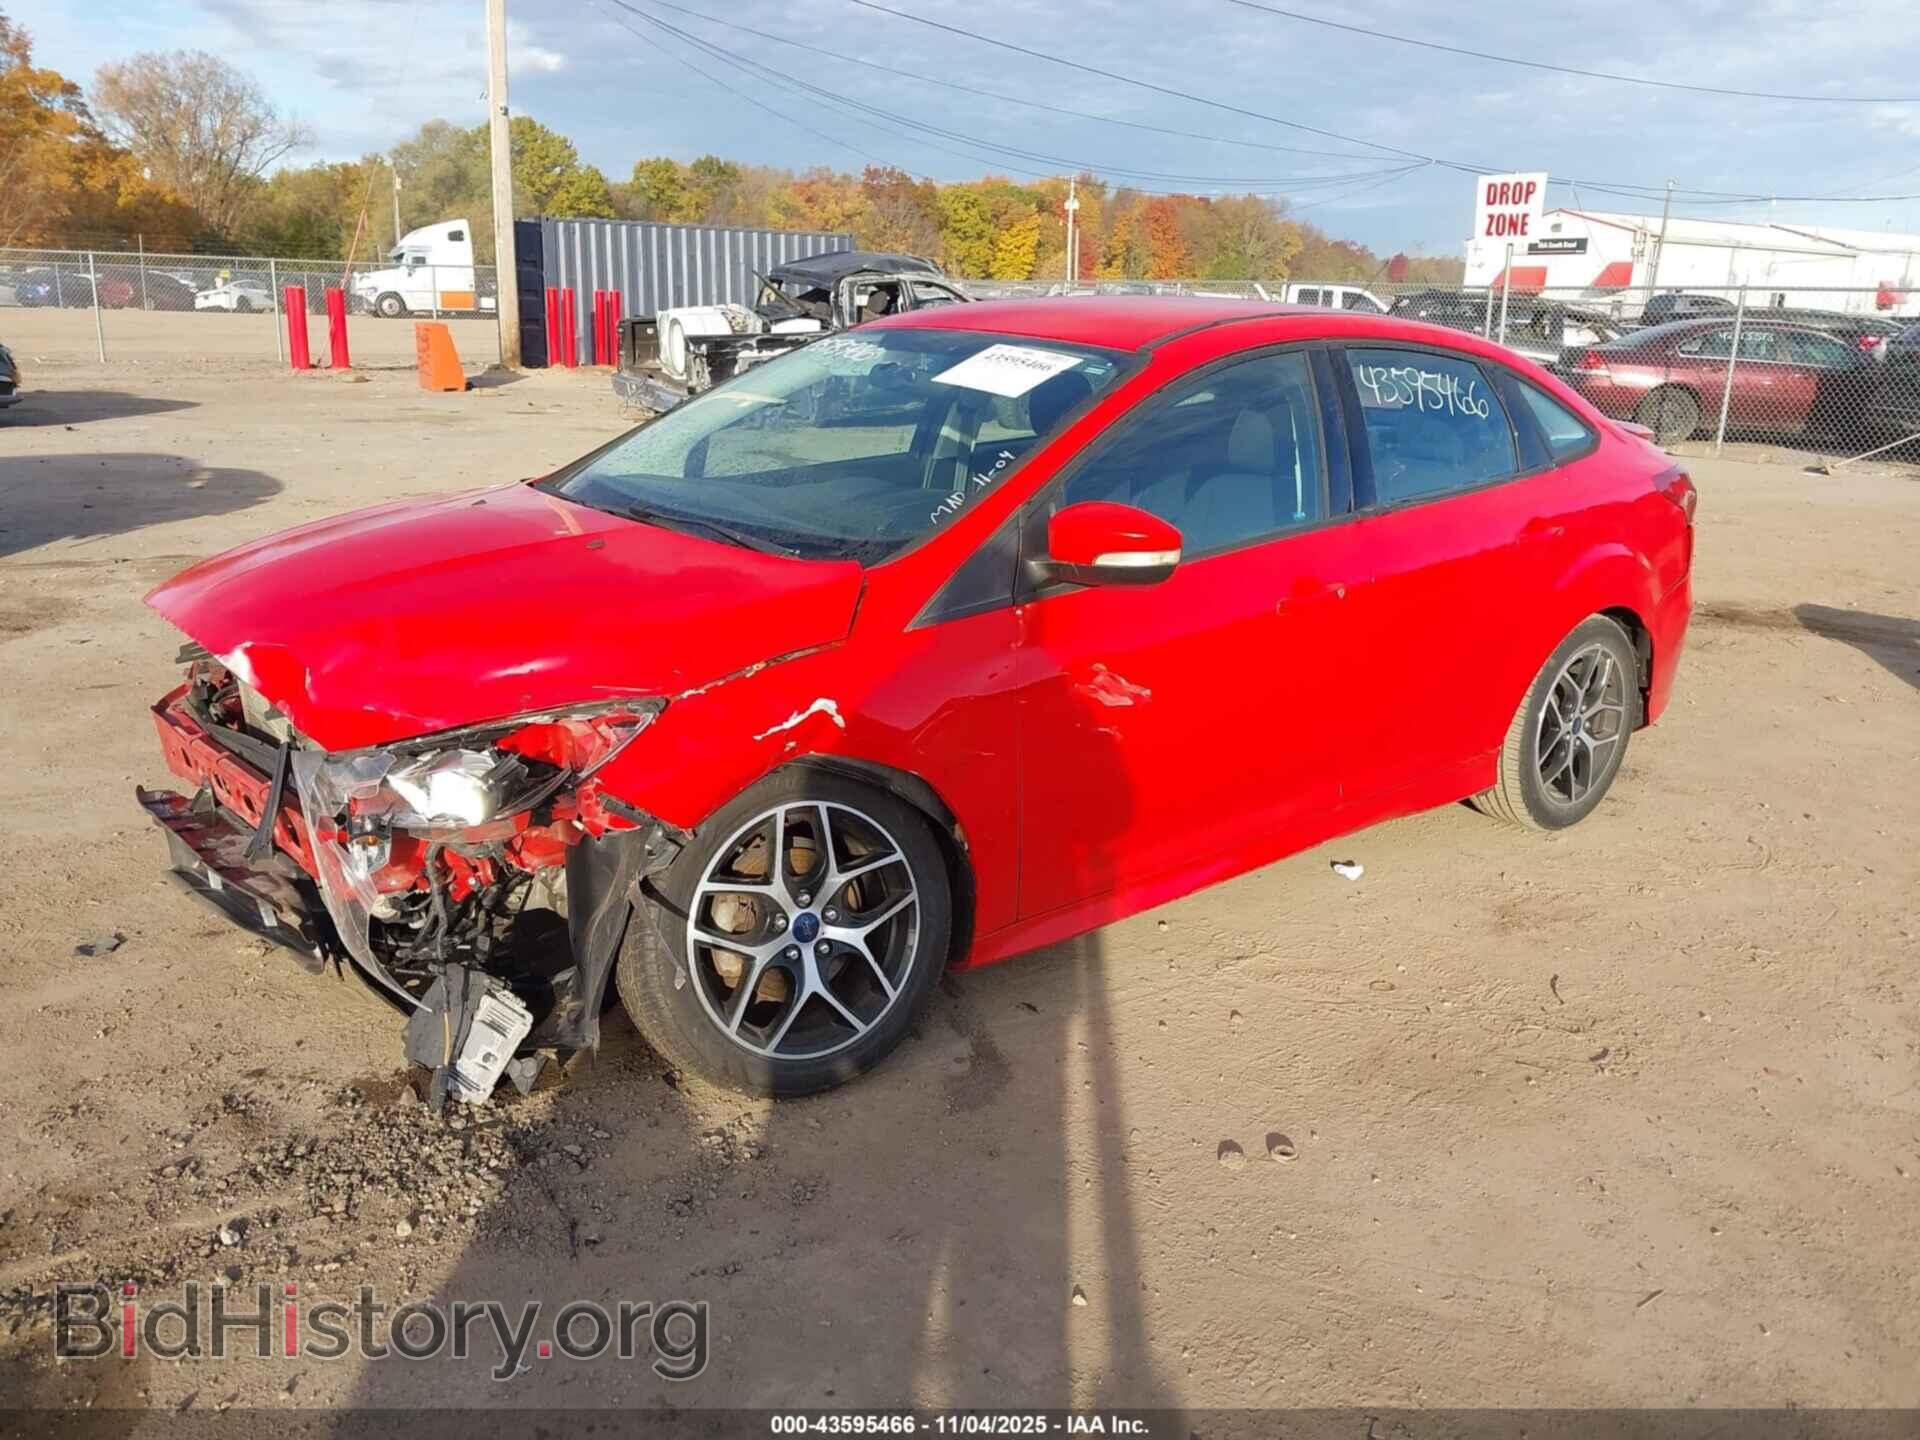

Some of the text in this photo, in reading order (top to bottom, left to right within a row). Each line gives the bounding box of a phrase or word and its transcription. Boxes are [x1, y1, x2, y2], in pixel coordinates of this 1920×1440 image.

[1486, 181, 1536, 206] DROP
[1485, 212, 1530, 237] ZONE
[1359, 364, 1489, 419] 43595466
